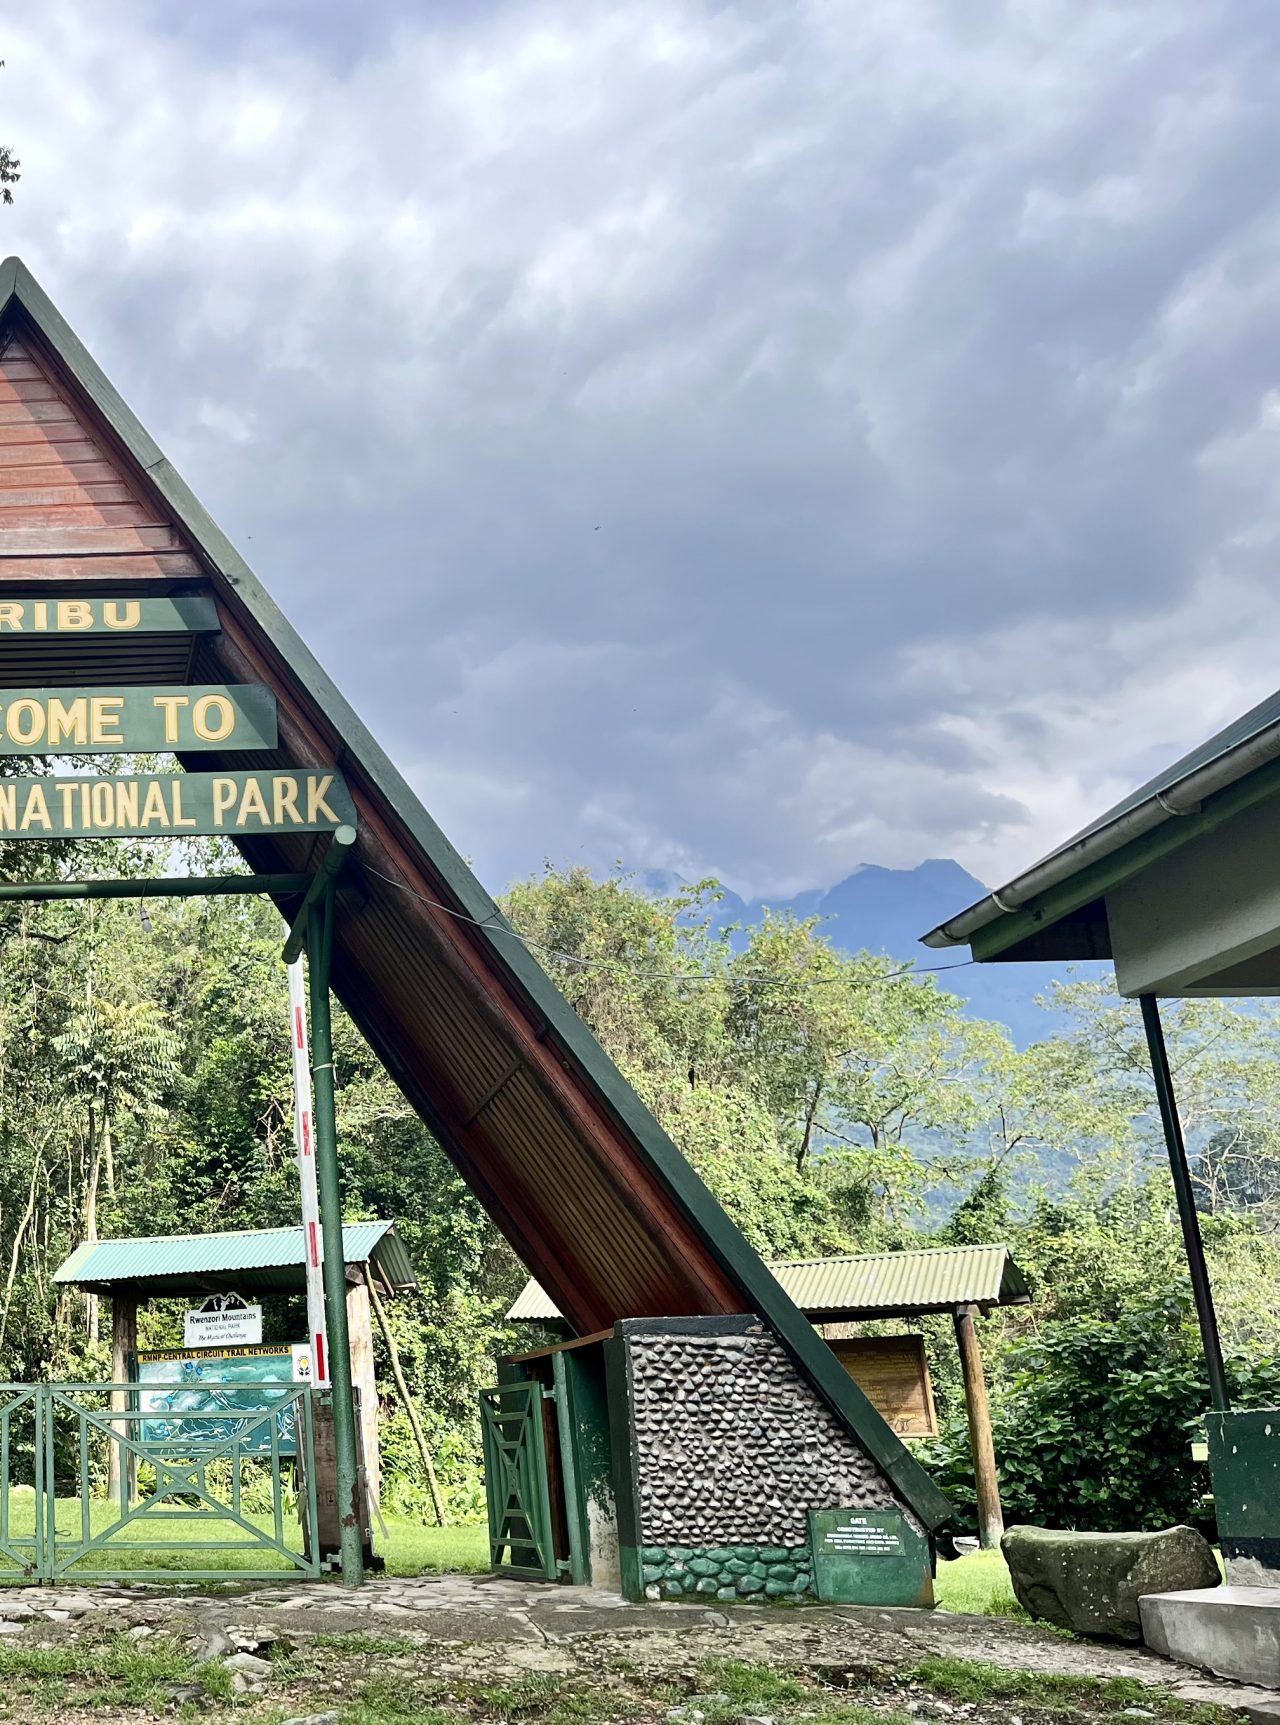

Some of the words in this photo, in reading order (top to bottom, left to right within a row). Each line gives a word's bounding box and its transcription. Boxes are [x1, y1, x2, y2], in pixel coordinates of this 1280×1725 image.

[153, 693, 237, 743] TO
[212, 775, 340, 826] PARK
[189, 1316, 221, 1325] Rwenzori
[221, 1312, 257, 1322] Mountains
[196, 1350, 224, 1360] CIRCUIT
[226, 1349, 246, 1357] TRAIL
[248, 1346, 289, 1356] NETWORKS
[850, 1517, 867, 1525] GATE
